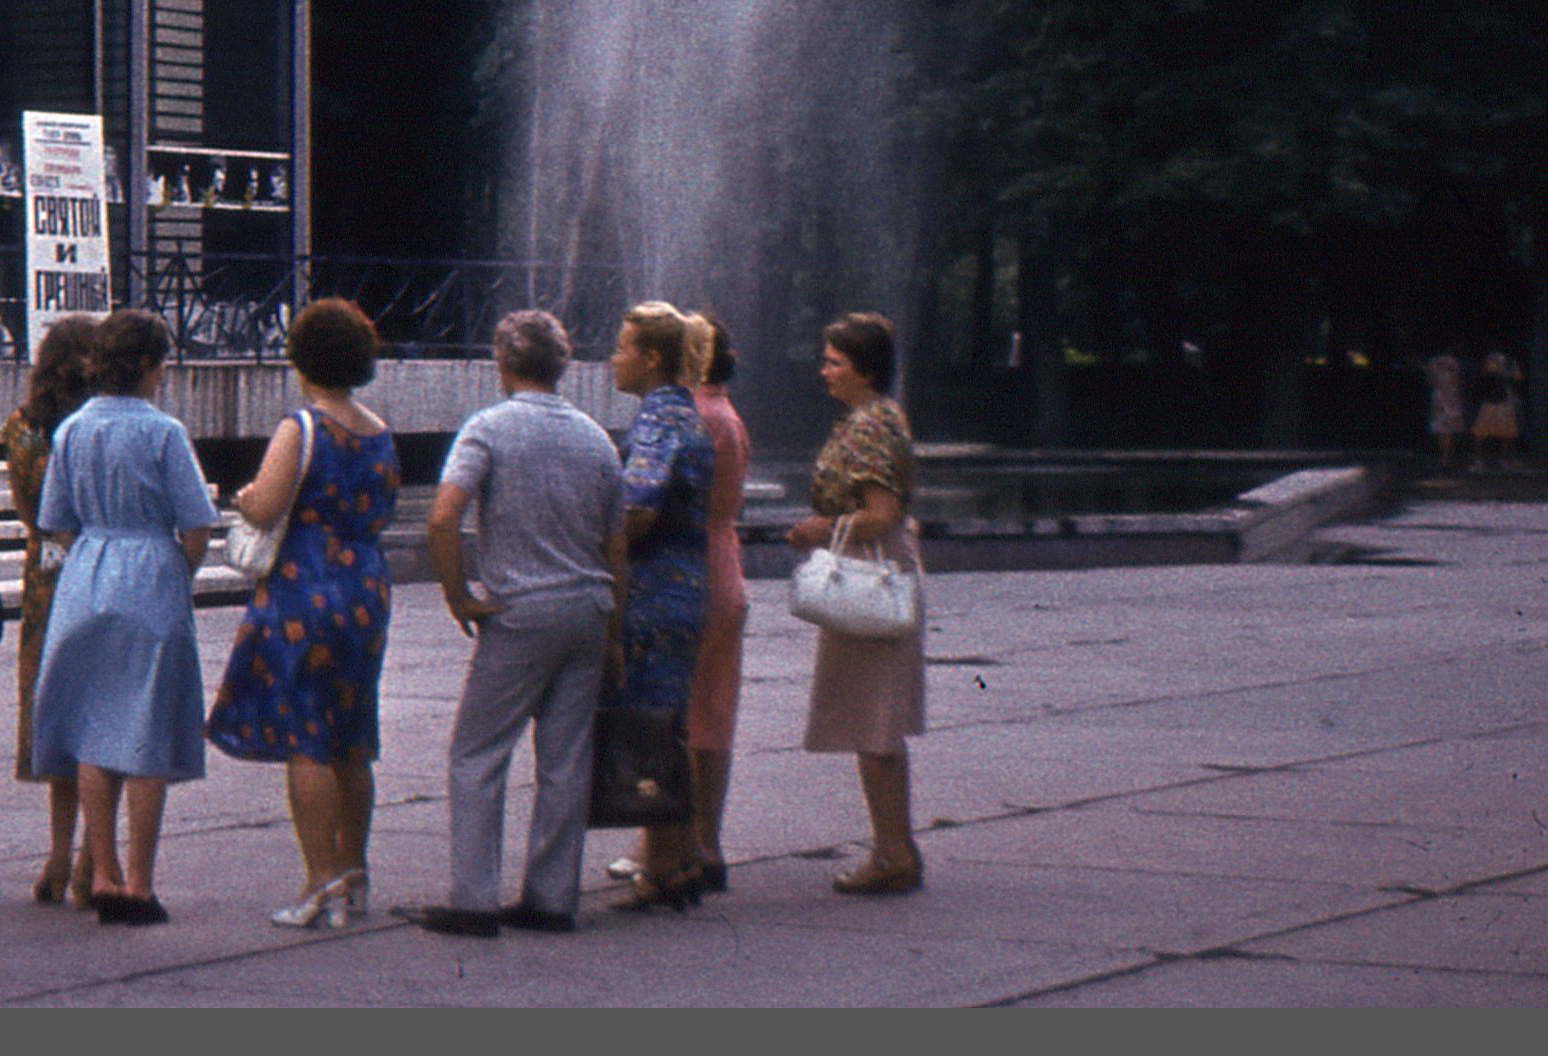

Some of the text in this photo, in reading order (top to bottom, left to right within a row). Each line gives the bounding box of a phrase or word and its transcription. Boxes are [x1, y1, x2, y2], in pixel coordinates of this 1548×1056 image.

[34, 193, 101, 235] СВЯТОЙ
[55, 243, 77, 264] И
[34, 266, 108, 312] ГРЕШНЫЙ
